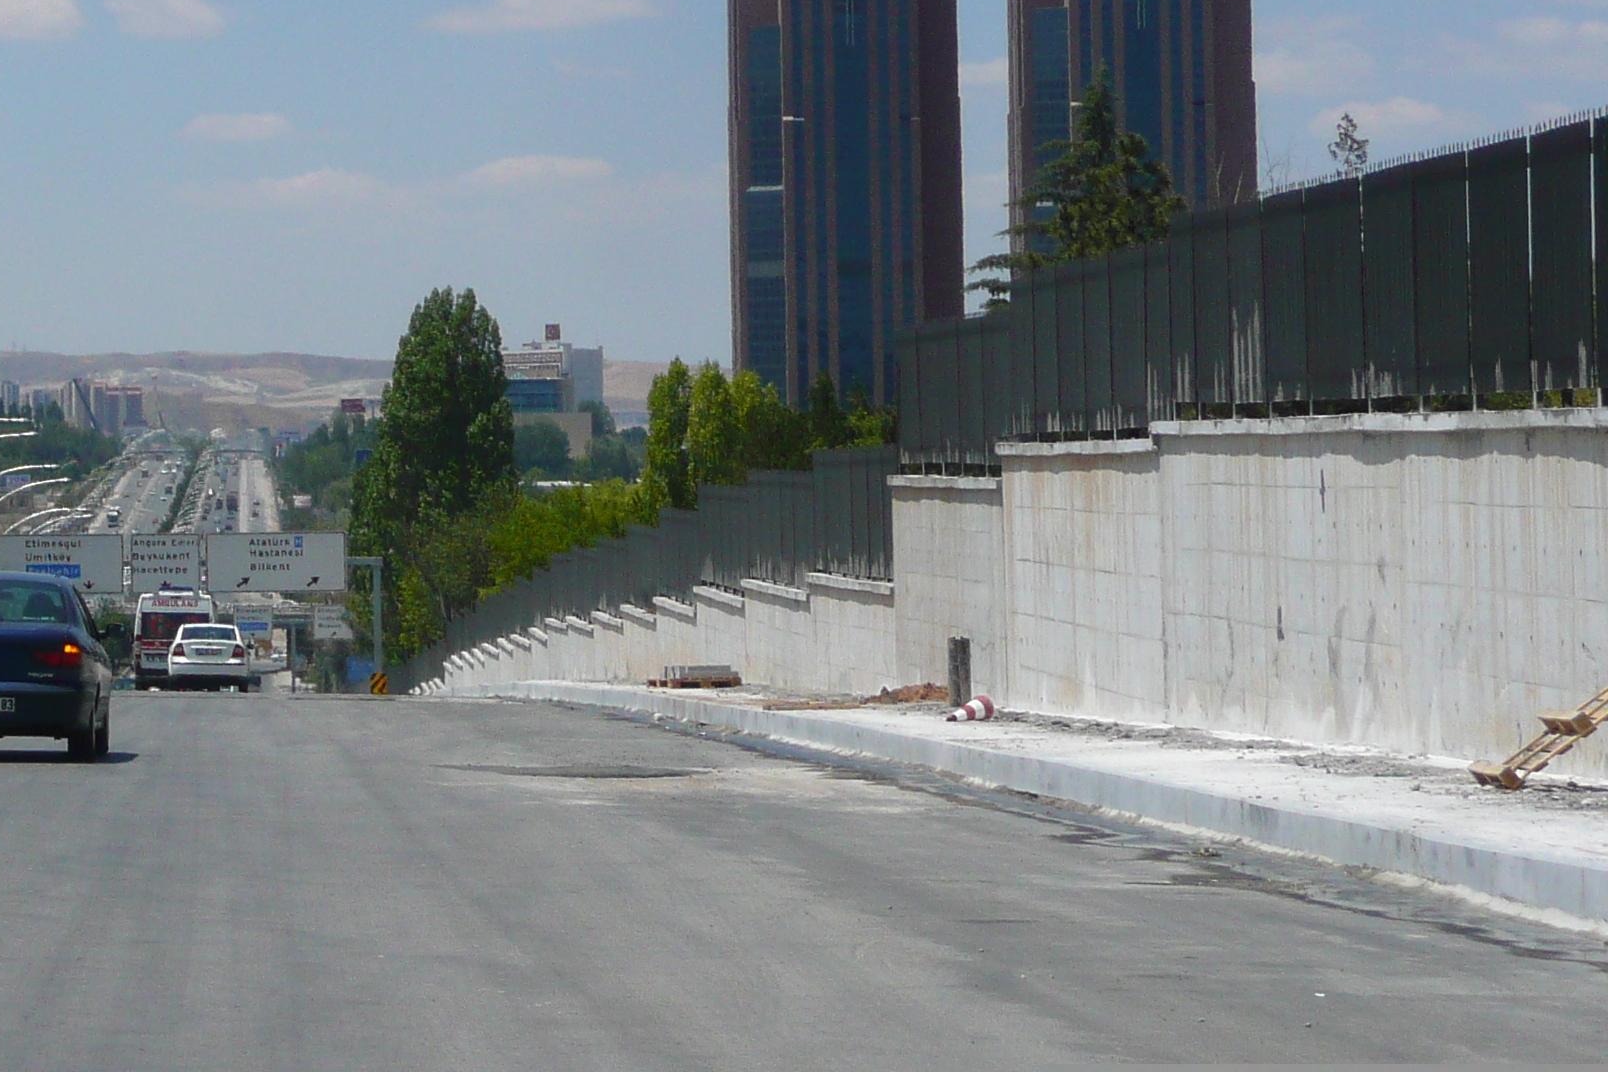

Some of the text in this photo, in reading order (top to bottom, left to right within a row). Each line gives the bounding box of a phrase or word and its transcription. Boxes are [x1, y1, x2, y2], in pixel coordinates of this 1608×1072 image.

[249, 536, 290, 546] Atatürk
[249, 549, 304, 557] Hastanesi
[250, 562, 290, 571] Bilkent
